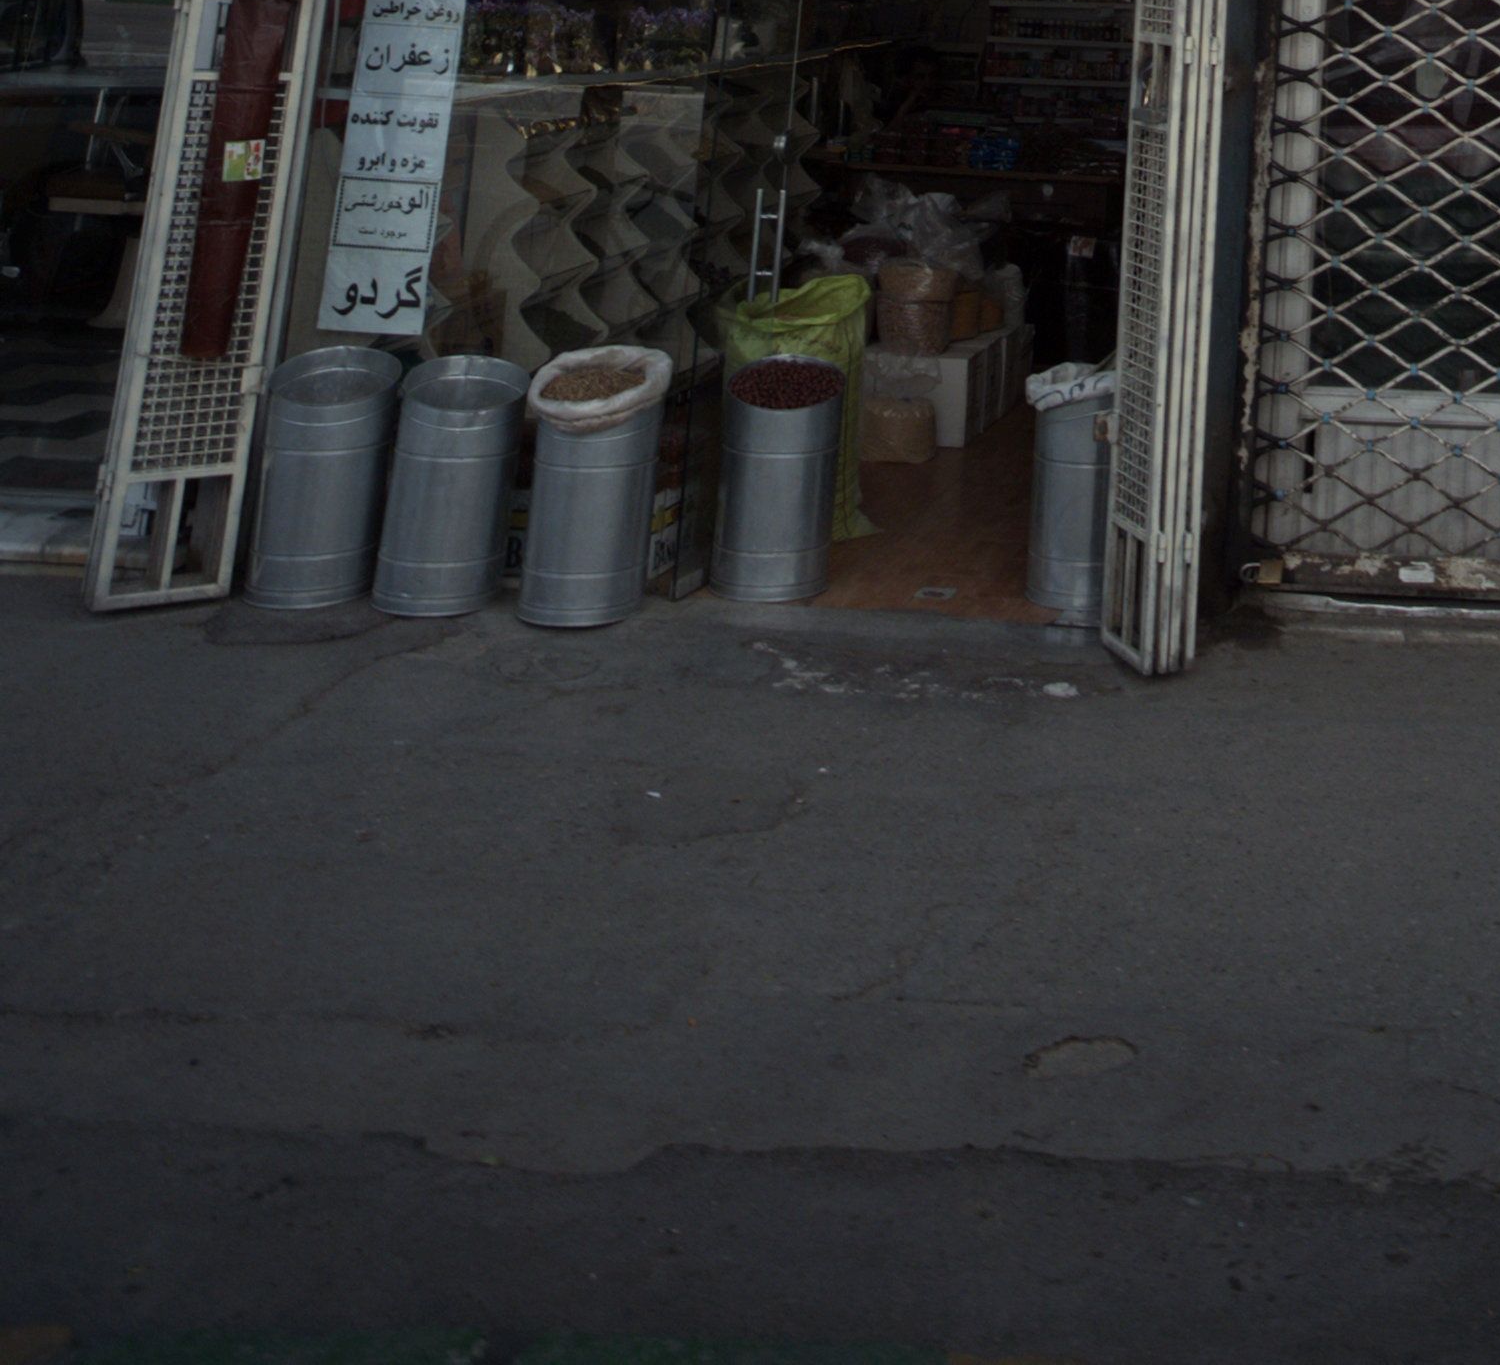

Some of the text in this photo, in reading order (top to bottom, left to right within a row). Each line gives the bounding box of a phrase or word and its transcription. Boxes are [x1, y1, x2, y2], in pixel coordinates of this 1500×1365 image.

[372, 0, 461, 24] روغن خراطین
[364, 41, 450, 75] زعفران
[350, 110, 439, 134] تقویت کننده
[356, 152, 386, 171] ابرو
[388, 158, 397, 173] و
[402, 185, 430, 214] آلو
[332, 265, 423, 320] گردو
